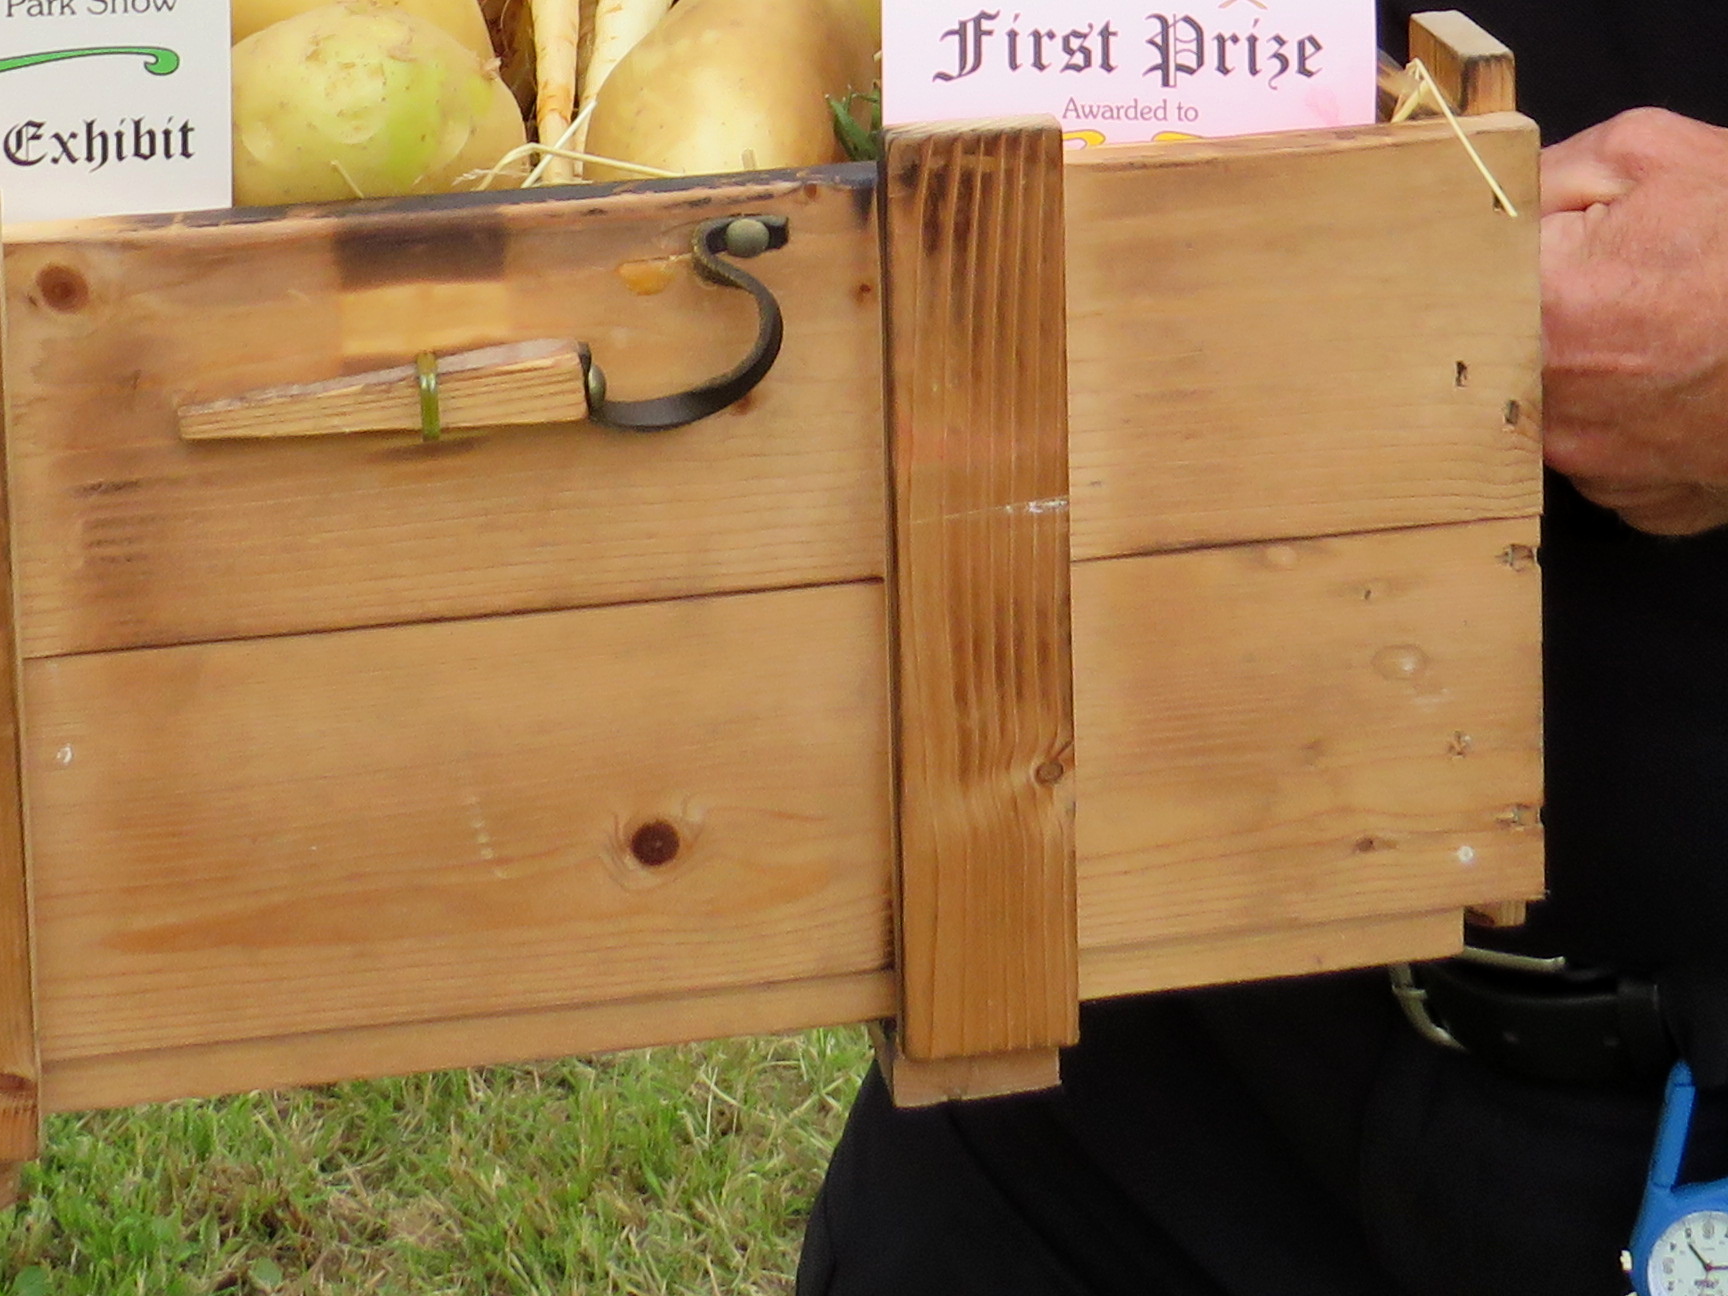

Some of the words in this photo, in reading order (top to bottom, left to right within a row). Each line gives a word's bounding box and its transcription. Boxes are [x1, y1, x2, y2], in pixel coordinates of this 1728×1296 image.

[933, 11, 1117, 81] First
[1143, 14, 1322, 90] Prize
[1062, 97, 1168, 121] Awarded
[1177, 102, 1198, 122] to
[4, 117, 194, 170] Exhibit
